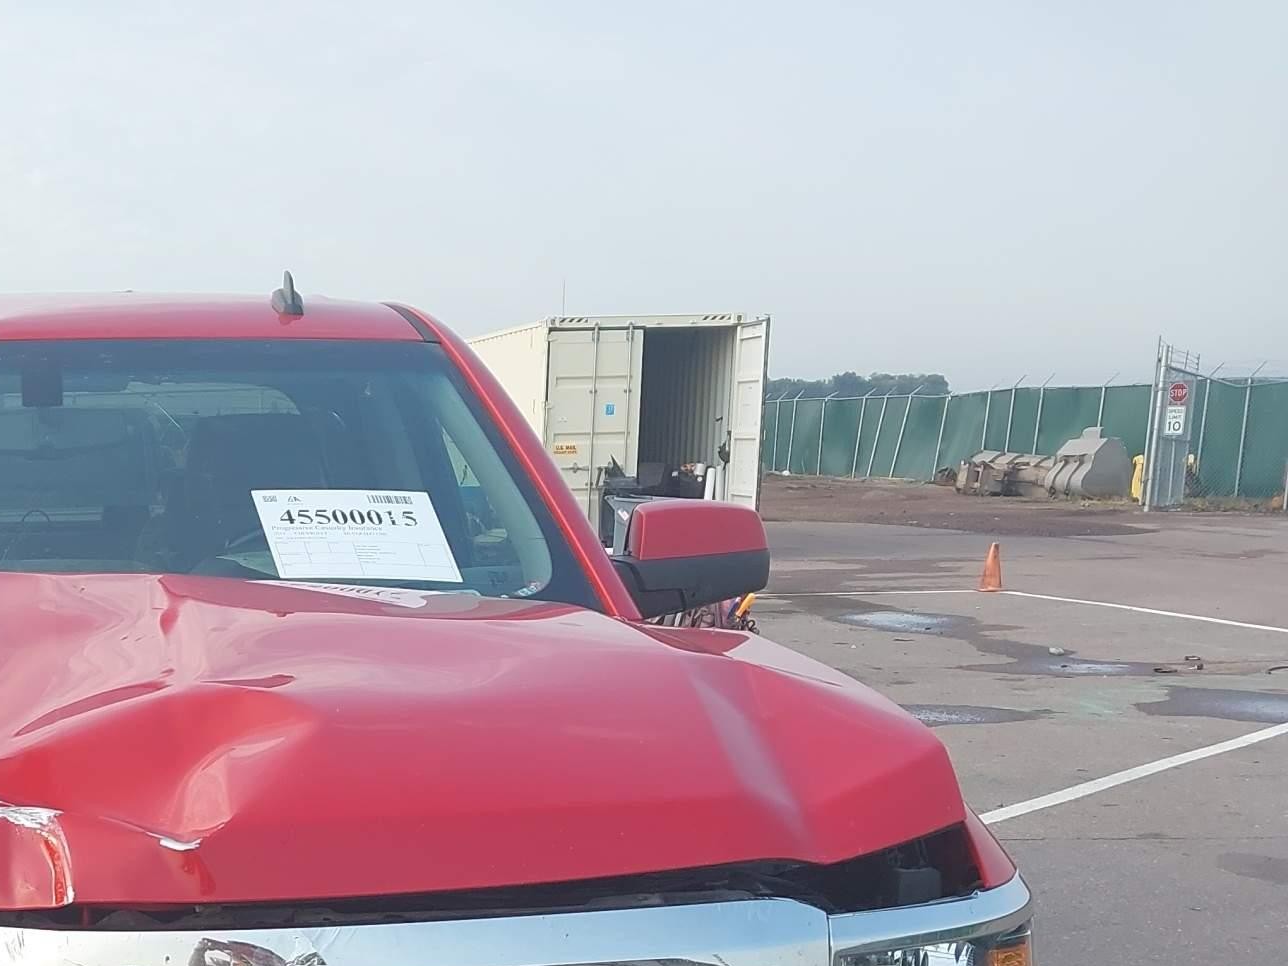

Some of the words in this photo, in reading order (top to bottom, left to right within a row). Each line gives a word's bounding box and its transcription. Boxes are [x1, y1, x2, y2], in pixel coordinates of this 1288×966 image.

[1170, 389, 1187, 397] STOP
[1167, 421, 1181, 432] 10
[280, 509, 418, 526] 45500015
